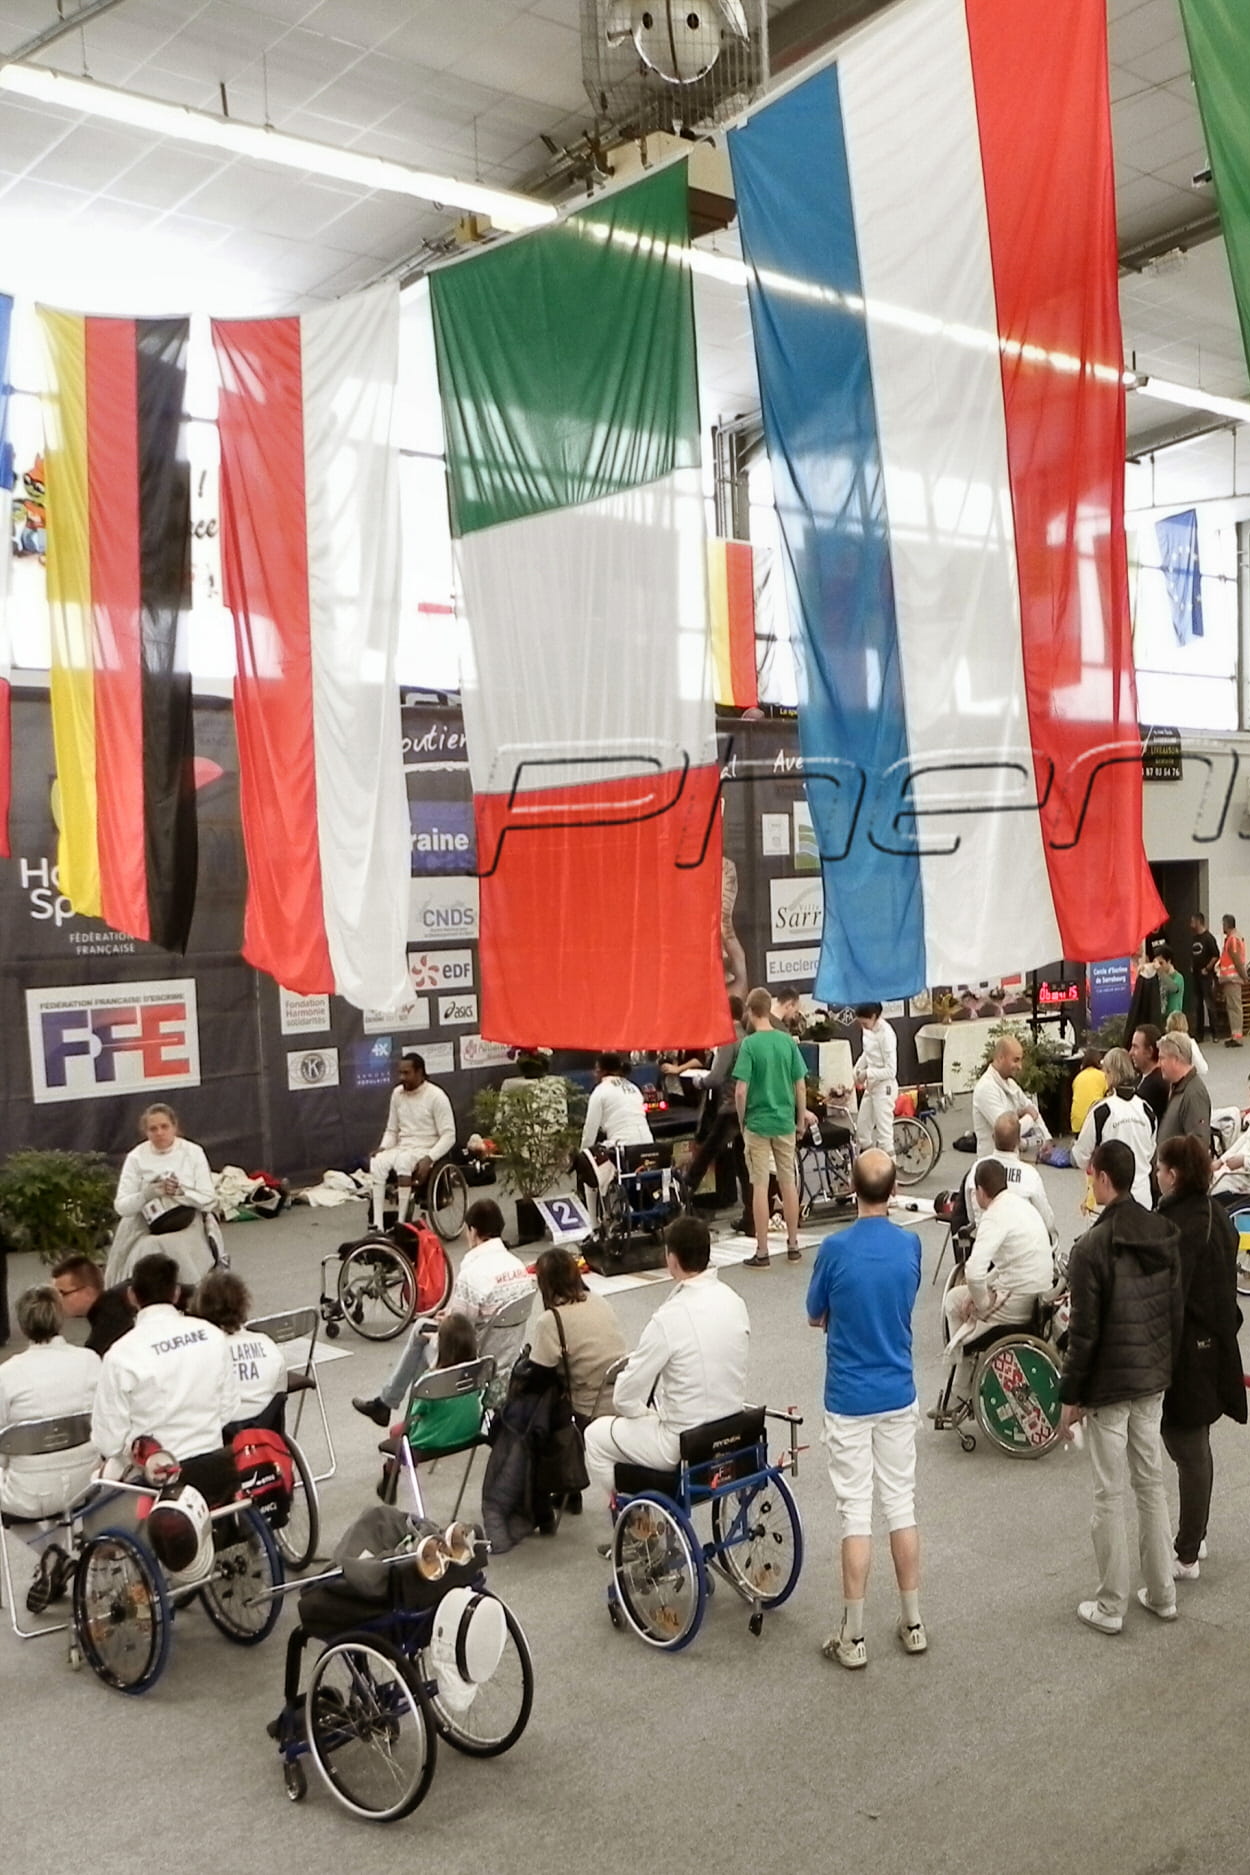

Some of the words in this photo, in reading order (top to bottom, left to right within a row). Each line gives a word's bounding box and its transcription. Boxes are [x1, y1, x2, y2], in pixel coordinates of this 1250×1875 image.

[423, 908, 475, 927] CNDS
[40, 1003, 190, 1088] FFE
[551, 1201, 579, 1225] 2
[151, 1329, 209, 1355] TOURAINE
[230, 1341, 267, 1361] LARME
